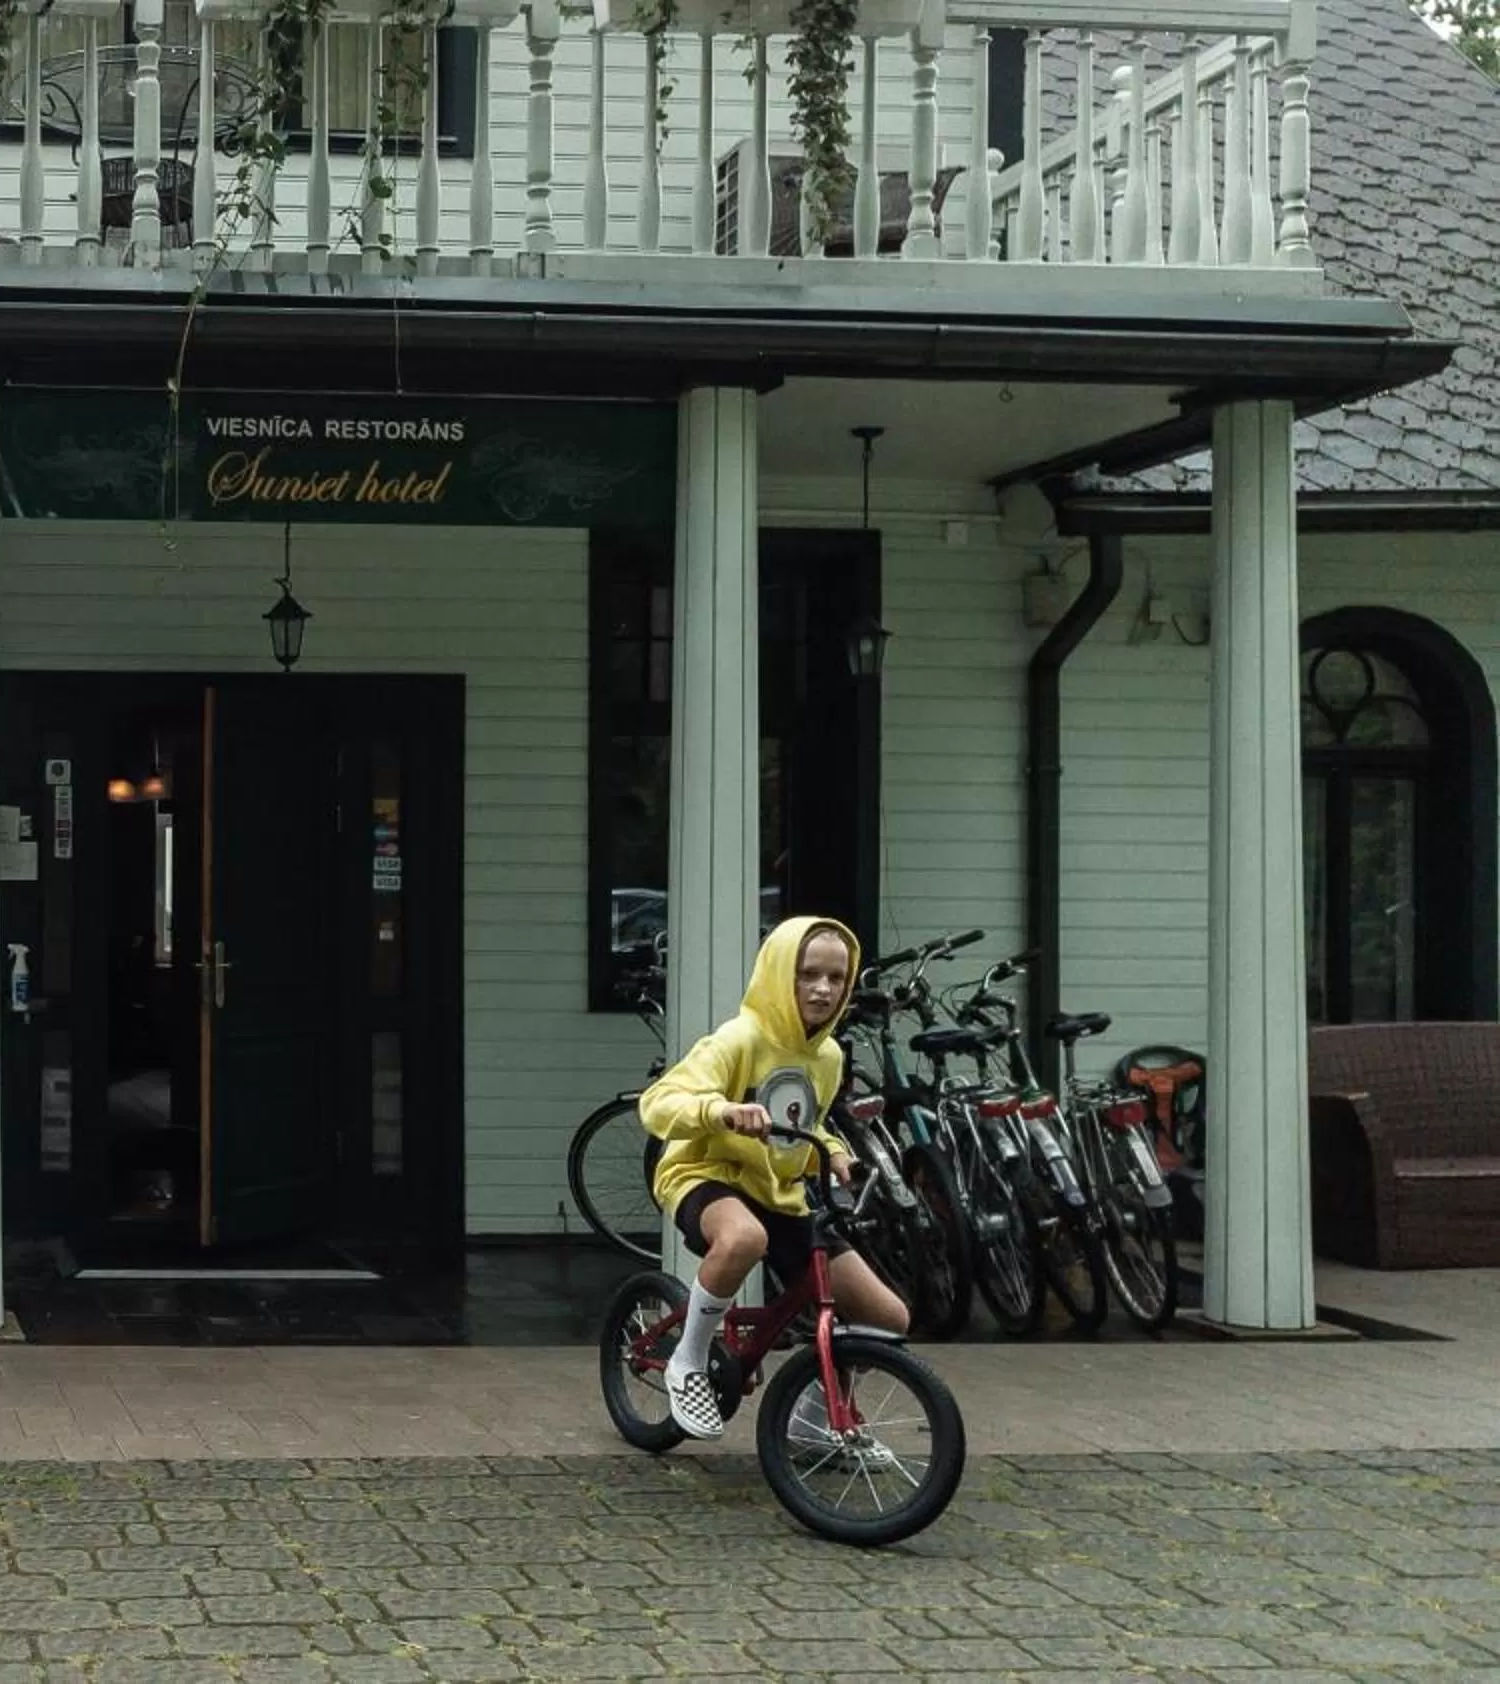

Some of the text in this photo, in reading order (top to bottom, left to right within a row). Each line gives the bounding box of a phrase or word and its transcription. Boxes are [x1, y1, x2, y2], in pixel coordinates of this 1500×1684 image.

[206, 416, 465, 441] VIESNĪCA RESTORĀNS
[208, 446, 453, 506] Sunset hotel
